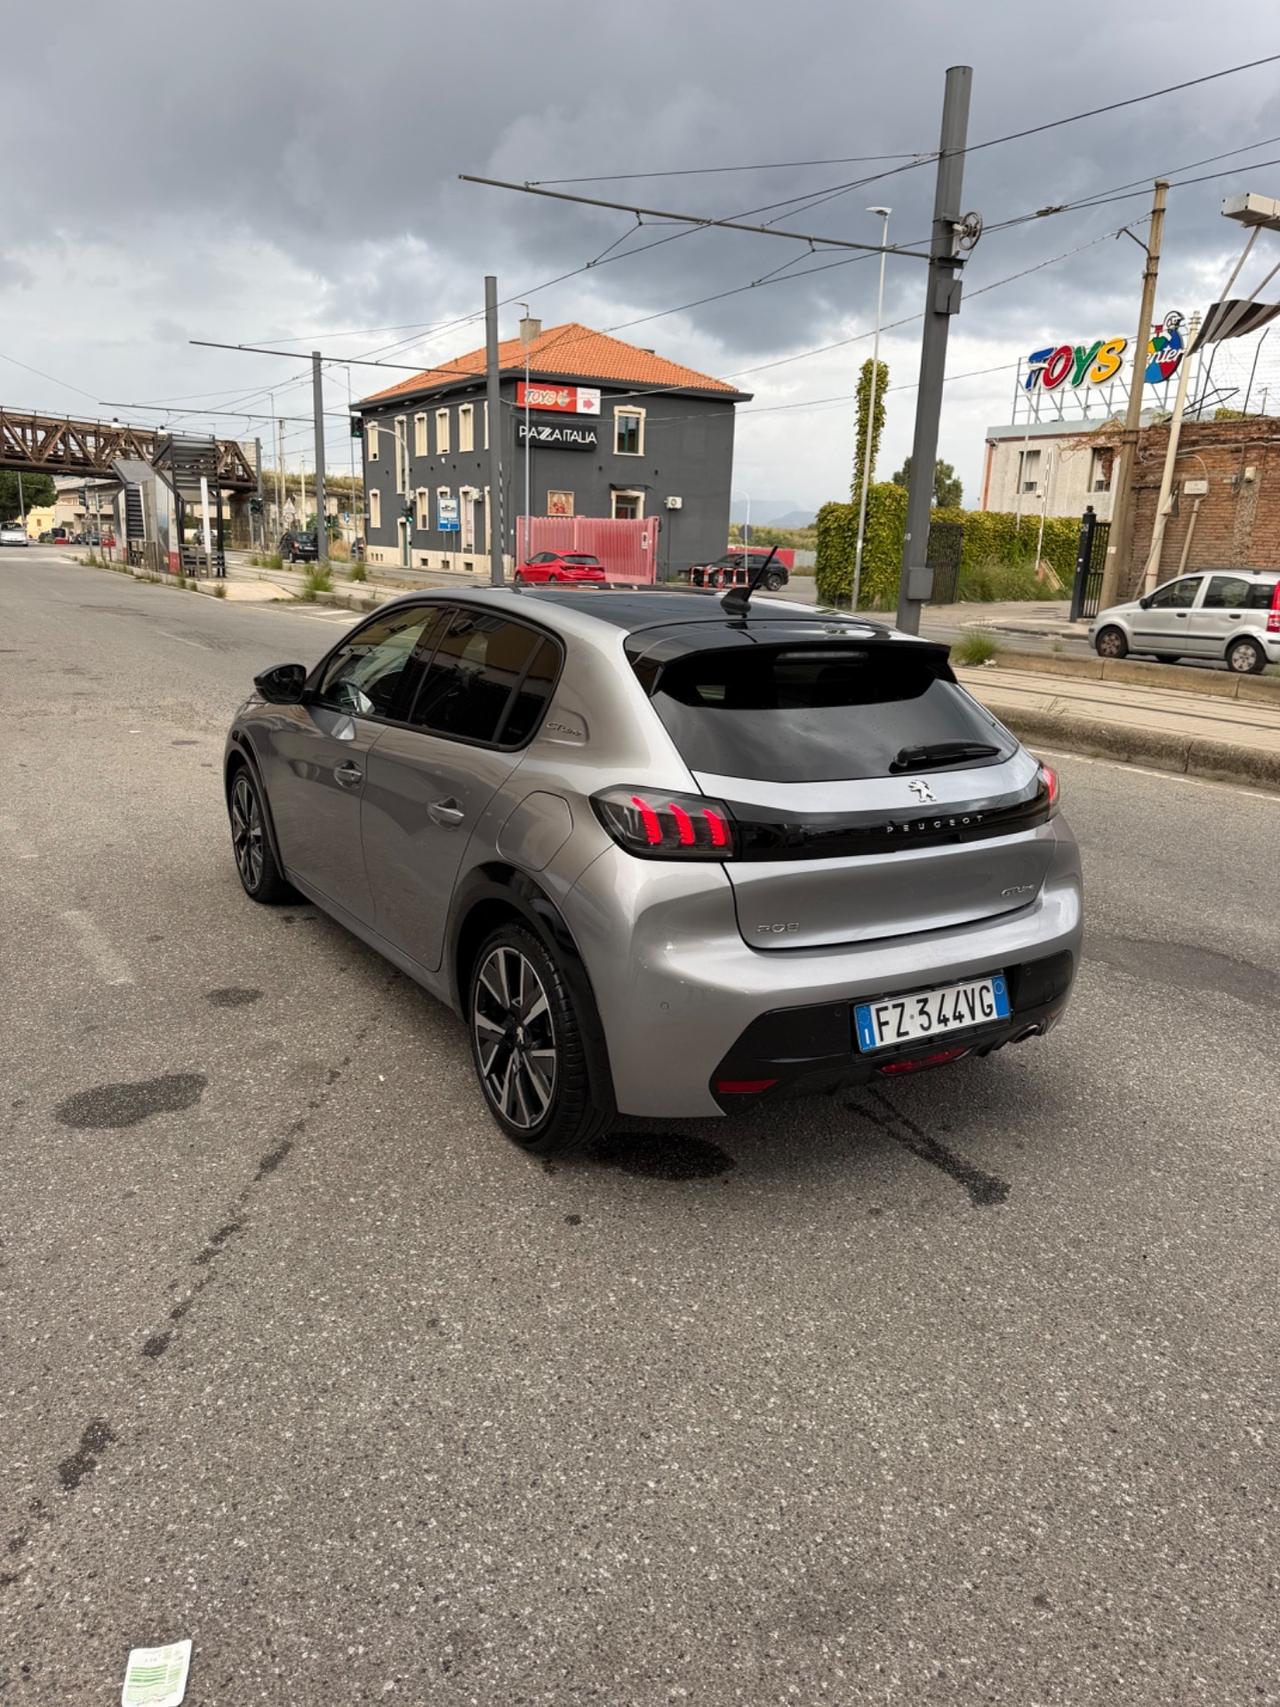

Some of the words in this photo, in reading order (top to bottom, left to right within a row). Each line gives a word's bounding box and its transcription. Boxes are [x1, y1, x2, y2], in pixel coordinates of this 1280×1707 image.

[1025, 338, 1127, 391] TOYS
[1145, 345, 1185, 364] enter
[525, 389, 557, 406] TOYS
[886, 814, 983, 834] PEUGEOT
